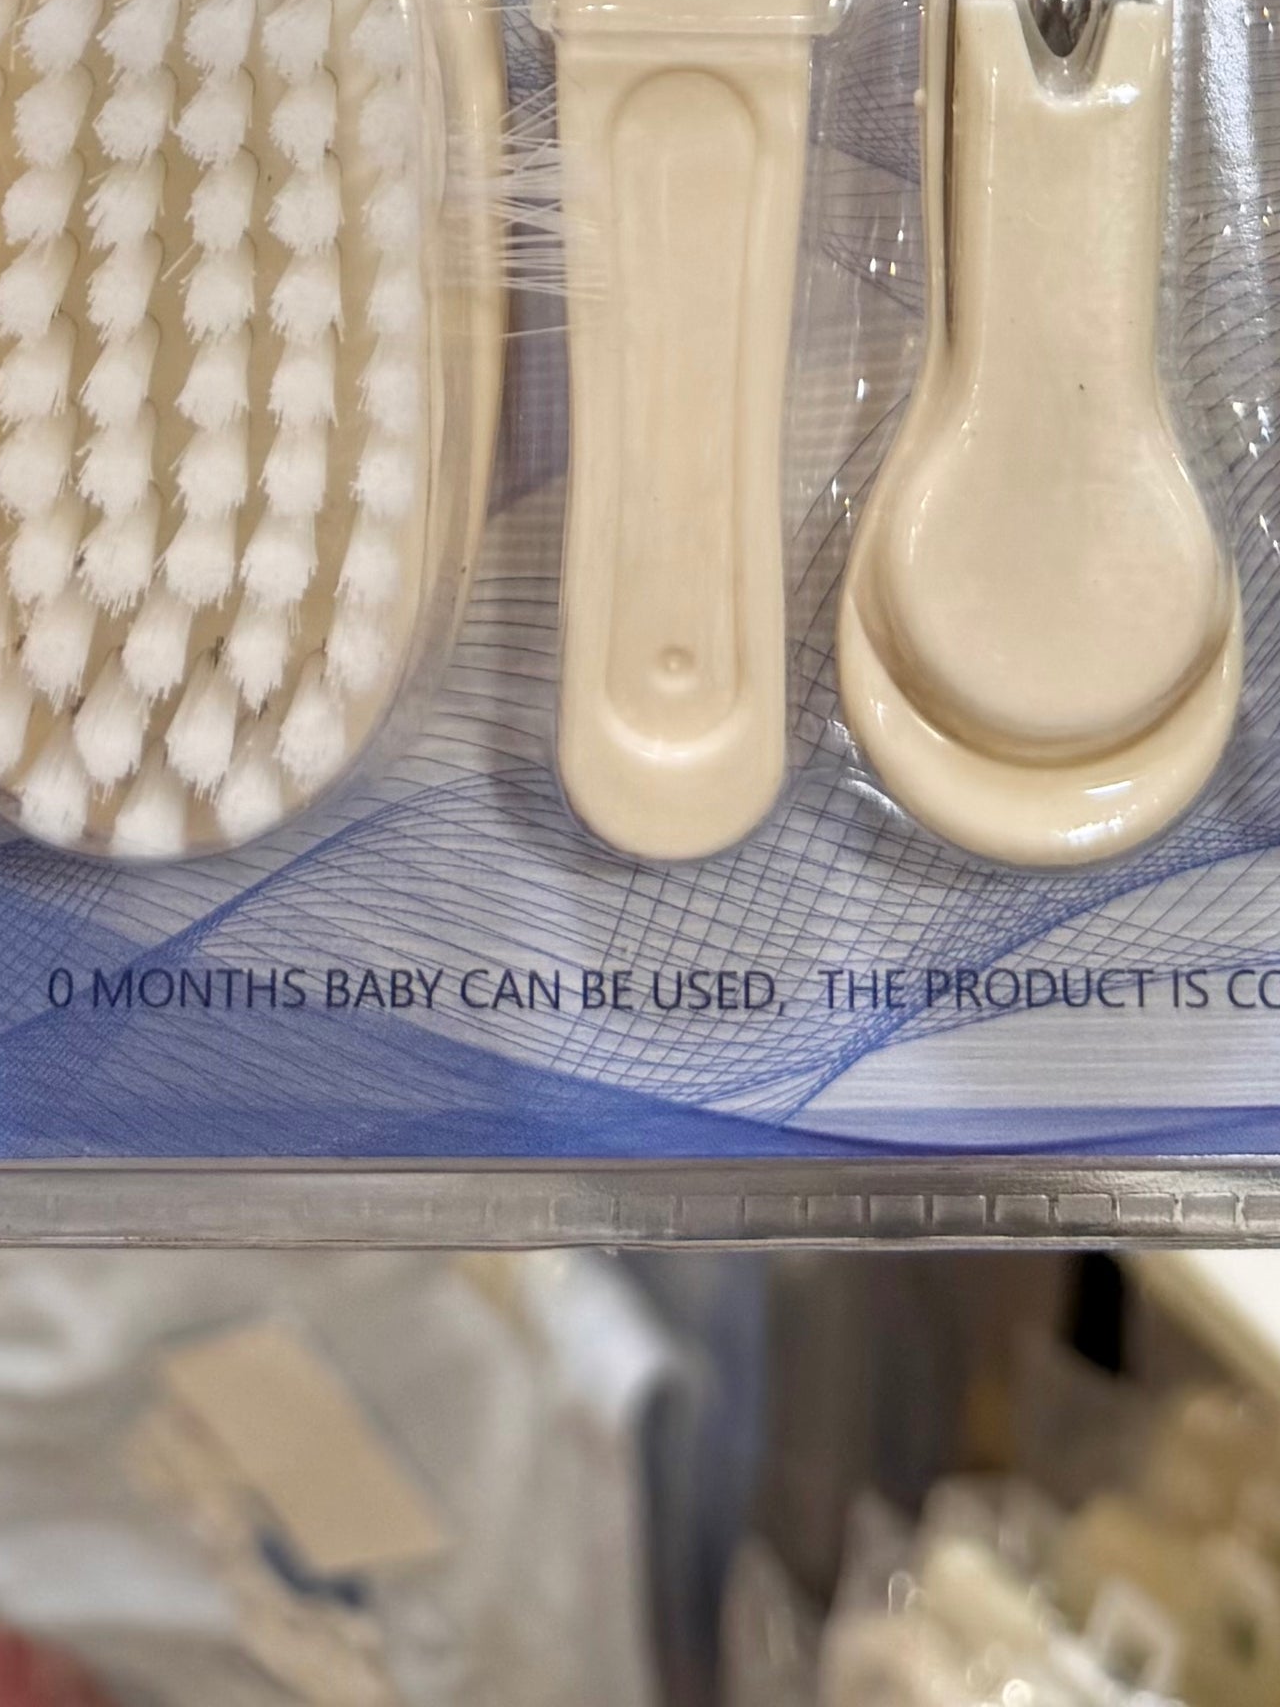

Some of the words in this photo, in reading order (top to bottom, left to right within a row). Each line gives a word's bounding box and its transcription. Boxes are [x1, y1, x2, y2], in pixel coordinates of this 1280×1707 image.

[48, 967, 72, 1009] 0
[93, 967, 308, 1009] MONTHS
[325, 968, 440, 1009] BABY
[459, 968, 560, 1009] CAN
[584, 969, 633, 1010] BE
[652, 969, 786, 1016] USED,
[819, 969, 907, 1010] THE
[926, 968, 1154, 1010] PRODUCT
[1173, 969, 1208, 1010] IS
